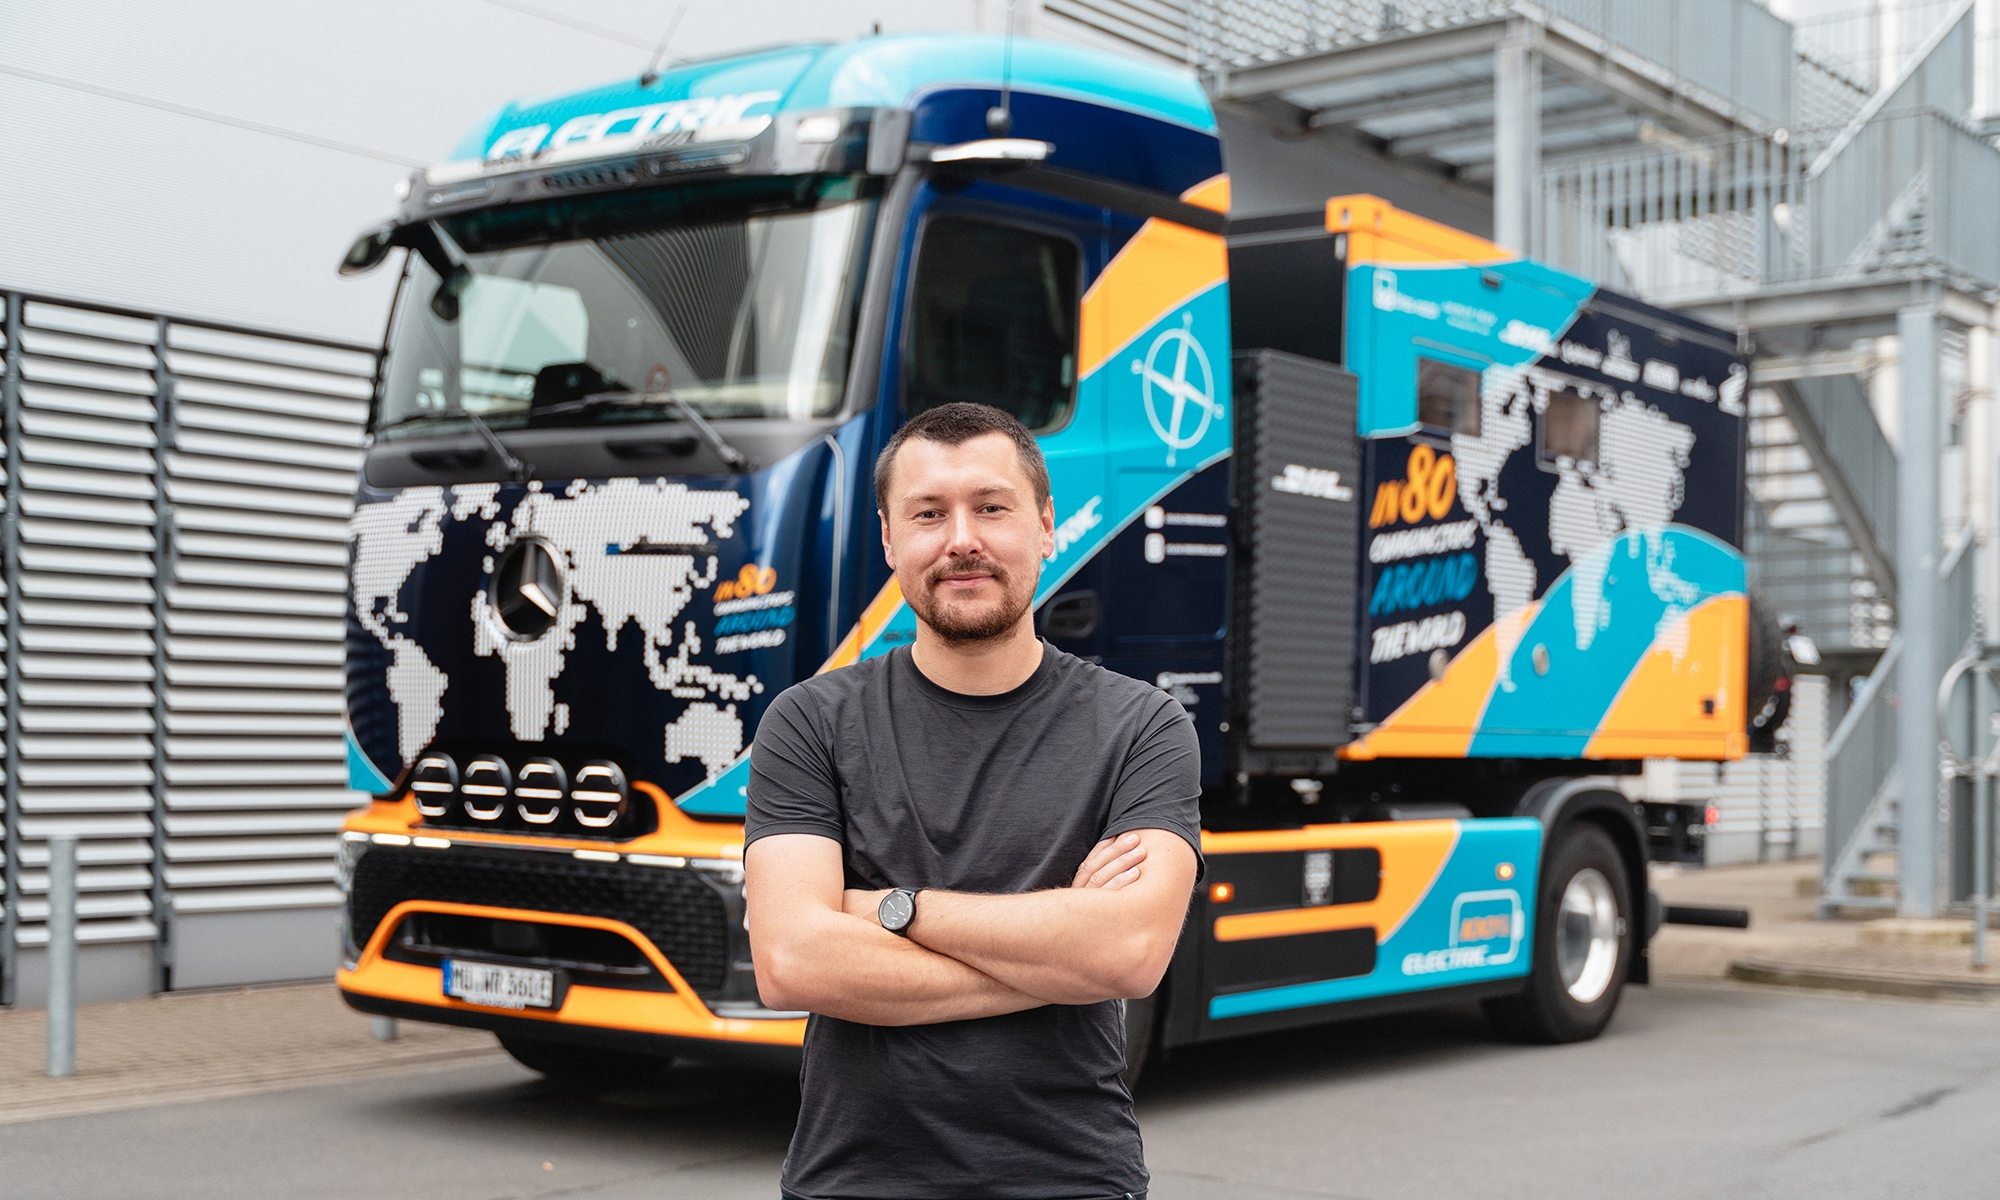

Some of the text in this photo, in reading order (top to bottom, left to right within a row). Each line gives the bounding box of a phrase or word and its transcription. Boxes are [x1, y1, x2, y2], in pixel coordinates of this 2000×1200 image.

[1401, 444, 1457, 523] 80
[734, 563, 777, 598] 80
[1369, 551, 1478, 618] AROUND
[713, 606, 796, 637] AROUND
[1405, 610, 1466, 655] WORLD
[1402, 945, 1489, 975] ELECTRIC
